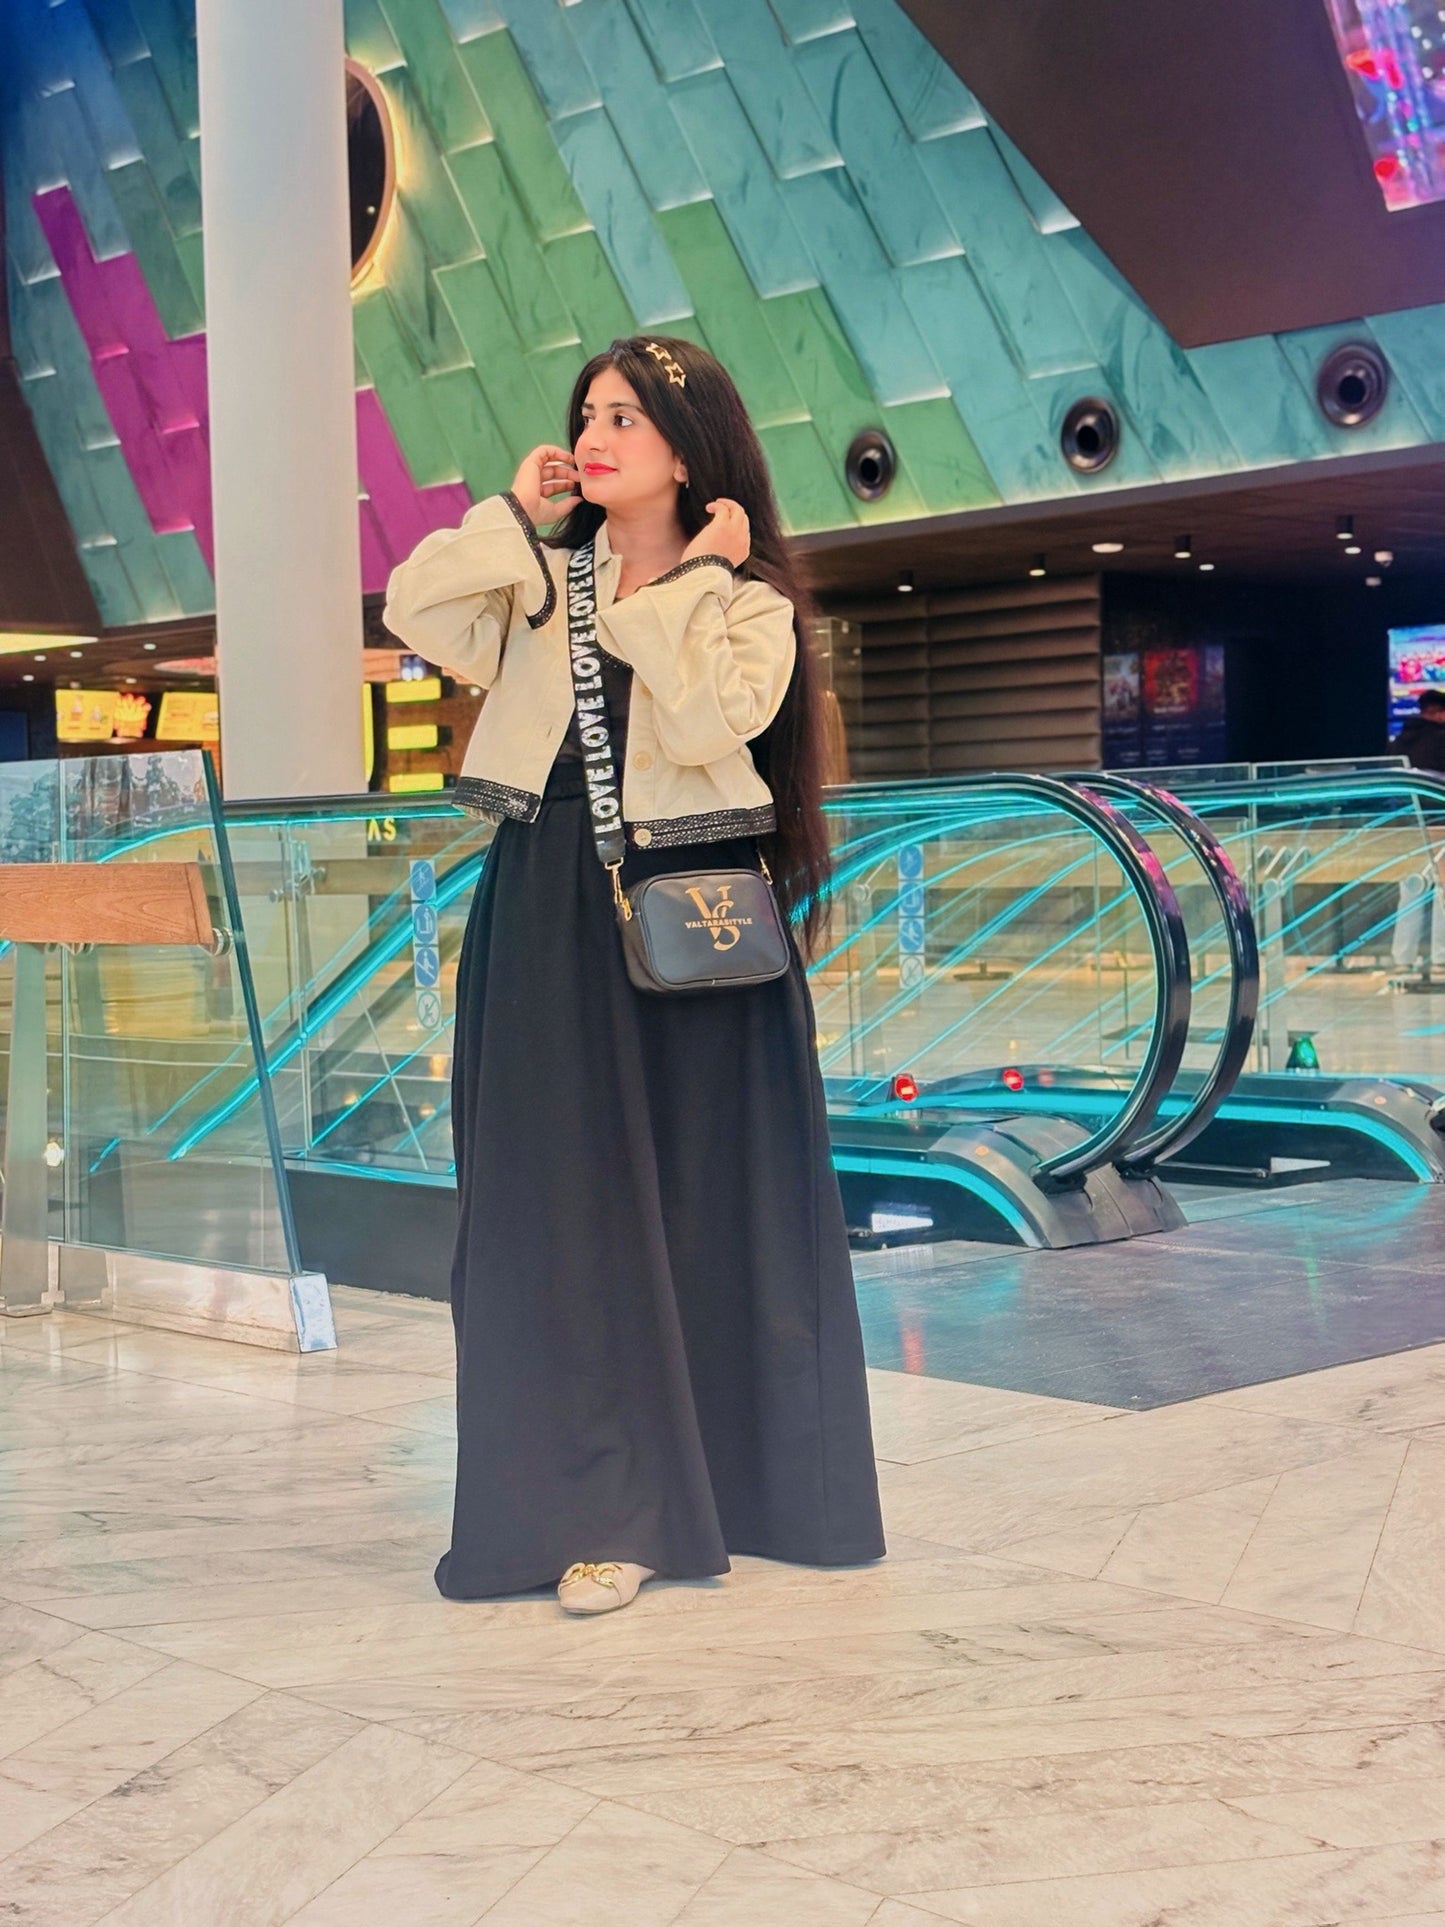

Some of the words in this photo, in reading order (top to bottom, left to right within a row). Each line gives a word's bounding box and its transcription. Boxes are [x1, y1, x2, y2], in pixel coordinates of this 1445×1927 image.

[568, 575, 596, 629] LOVE
[570, 629, 603, 692] LOVE
[577, 695, 613, 762] LOVE
[586, 764, 623, 834] LOVE
